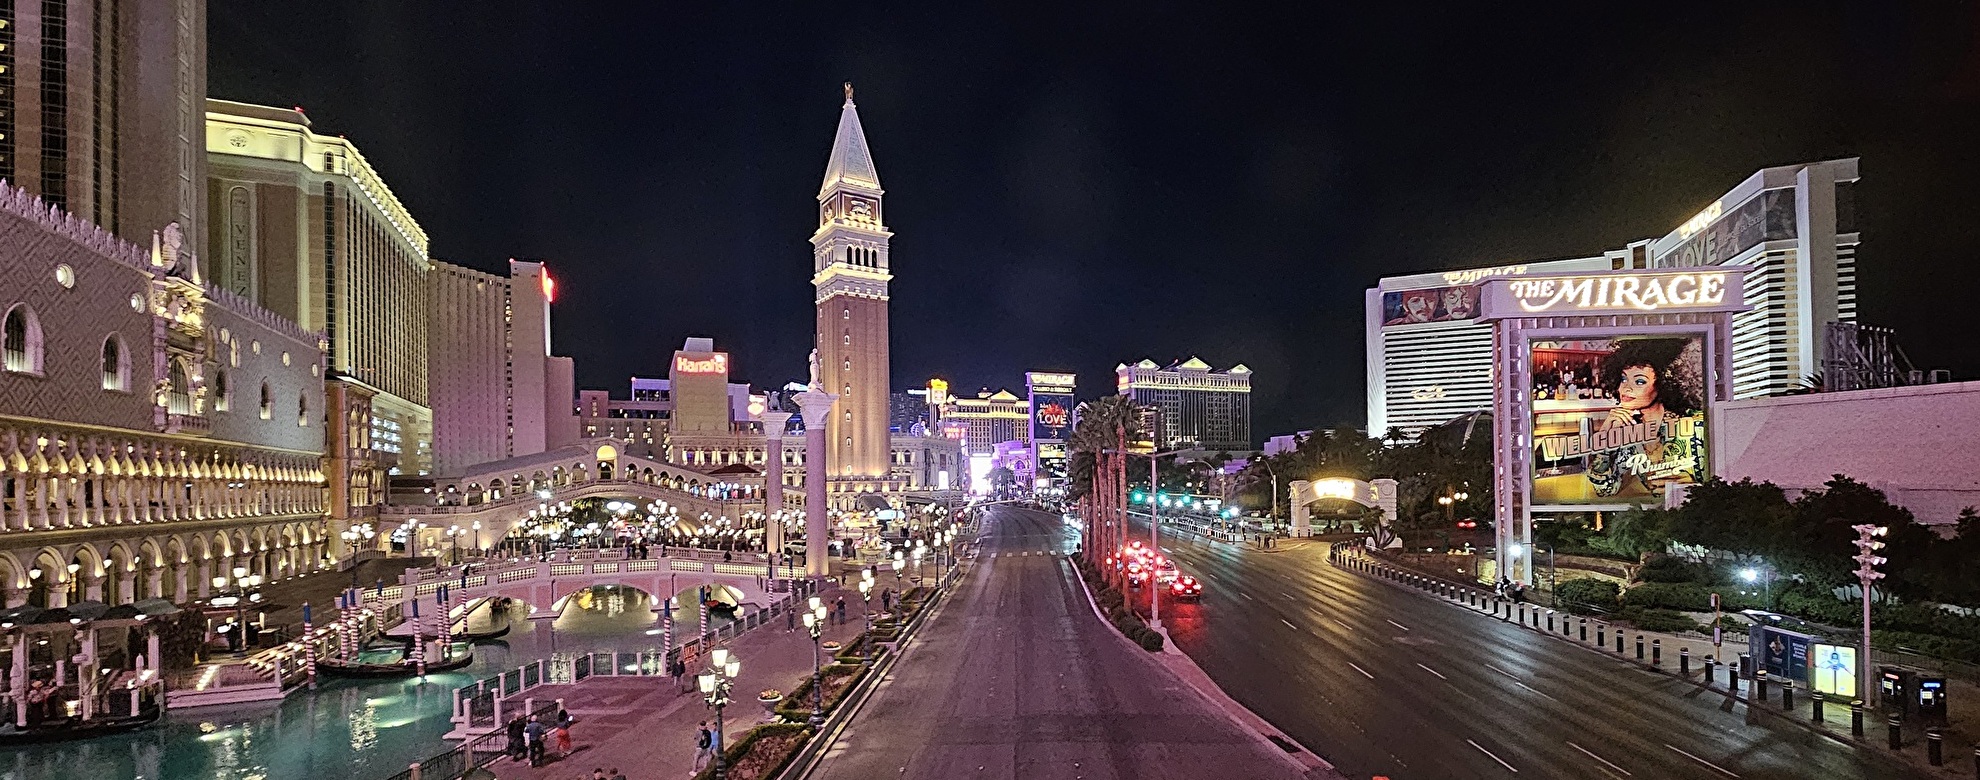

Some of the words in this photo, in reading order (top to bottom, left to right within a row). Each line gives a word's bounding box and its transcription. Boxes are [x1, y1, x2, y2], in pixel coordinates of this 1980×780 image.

[1510, 281, 1554, 299] THE
[1520, 273, 1725, 312] MIRAGE
[1039, 414, 1067, 424] LOVE
[1545, 420, 1658, 458] WELCOME
[1664, 416, 1695, 439] TO
